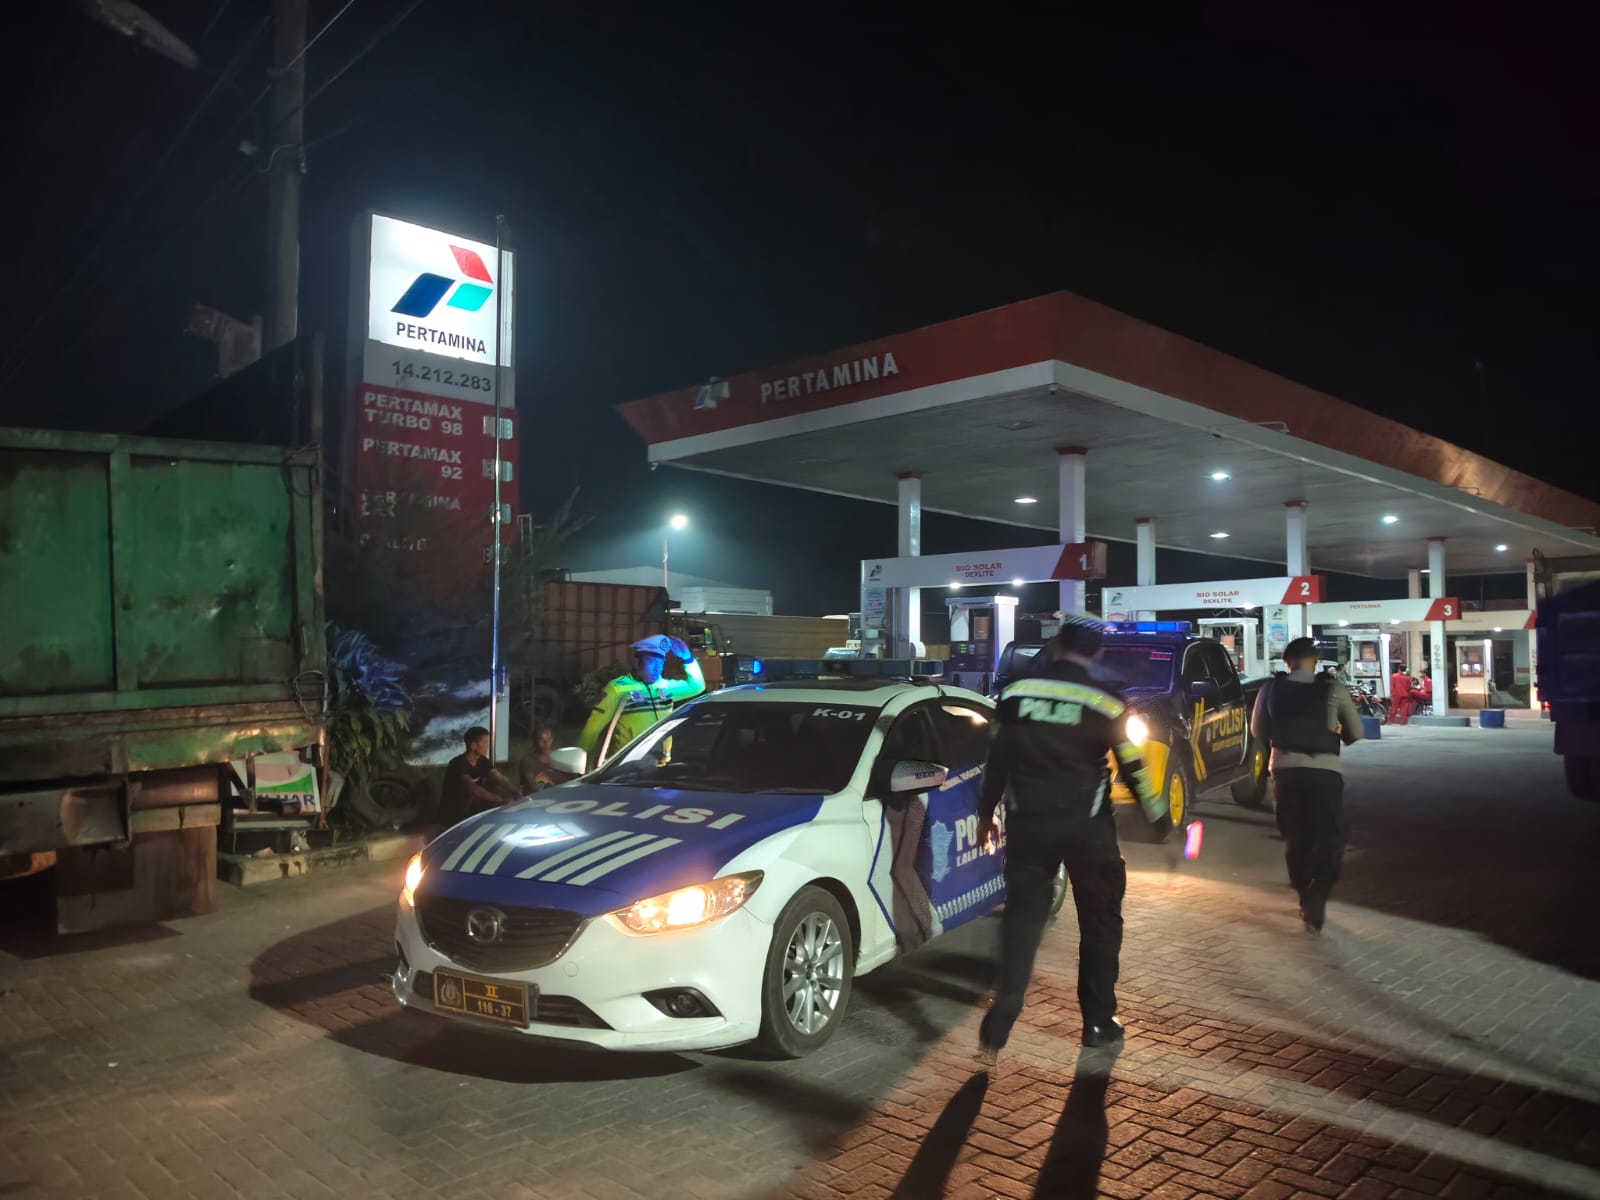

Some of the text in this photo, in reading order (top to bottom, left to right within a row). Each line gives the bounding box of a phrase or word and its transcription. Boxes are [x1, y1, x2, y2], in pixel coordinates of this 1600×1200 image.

[396, 321, 487, 354] PERTAMINA
[391, 359, 492, 392] 14.212.283
[760, 352, 899, 404] PERTAMINA
[364, 391, 462, 420] PERTAMAX
[440, 421, 463, 436] 98
[440, 464, 463, 480] 92
[955, 562, 1002, 572] BIO SOLAR
[1079, 553, 1088, 571] 1
[965, 570, 994, 578] DEXLITE
[1300, 582, 1310, 596] 2
[1443, 604, 1453, 616] 3
[812, 707, 867, 721] K-01
[1211, 706, 1244, 739] POLISI
[502, 799, 746, 830] POLISI
[956, 850, 977, 867] LALU
